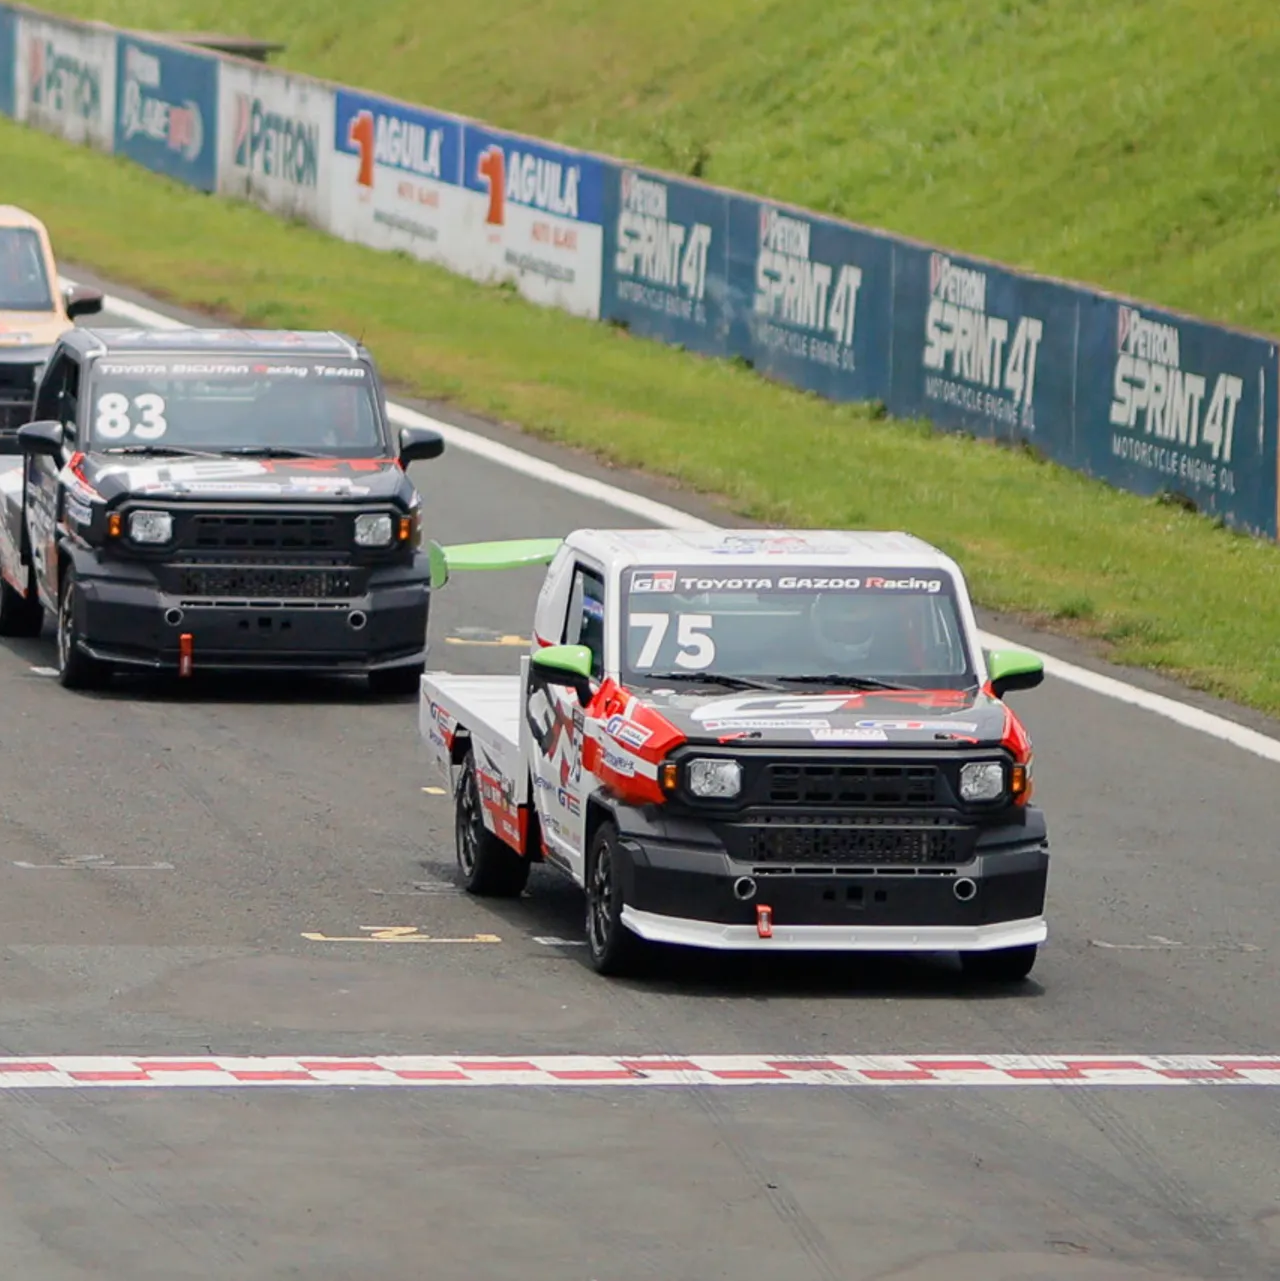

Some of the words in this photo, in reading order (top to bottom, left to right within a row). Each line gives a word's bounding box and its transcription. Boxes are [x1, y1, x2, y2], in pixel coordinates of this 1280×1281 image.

[251, 98, 317, 187] PETRON
[375, 115, 441, 177] AGUILA
[508, 152, 579, 217] AGUILA
[617, 211, 685, 287] SPRINT
[681, 223, 712, 300] 4T
[941, 258, 985, 310] PETRON
[755, 250, 832, 332] SPRINT
[828, 264, 862, 346] 4T
[923, 298, 1008, 390] SPRINT
[1005, 316, 1042, 411] 4T
[1128, 310, 1179, 367] PETRON
[100, 364, 167, 375] TOYOTA
[925, 376, 983, 412] MOTORCYCLE
[985, 396, 1018, 423] ENGINE
[96, 392, 167, 440] 83
[1109, 352, 1206, 448] SPRINT
[1203, 373, 1243, 462] 4T
[1112, 433, 1179, 475] MOTORCYCLE
[1180, 451, 1217, 487] ENGINE
[1220, 468, 1236, 493] OIL
[632, 573, 674, 591] GR
[681, 577, 772, 589] TOYOTA
[778, 577, 860, 589] GAZOO
[865, 577, 942, 592] Racing
[630, 613, 716, 669] 75
